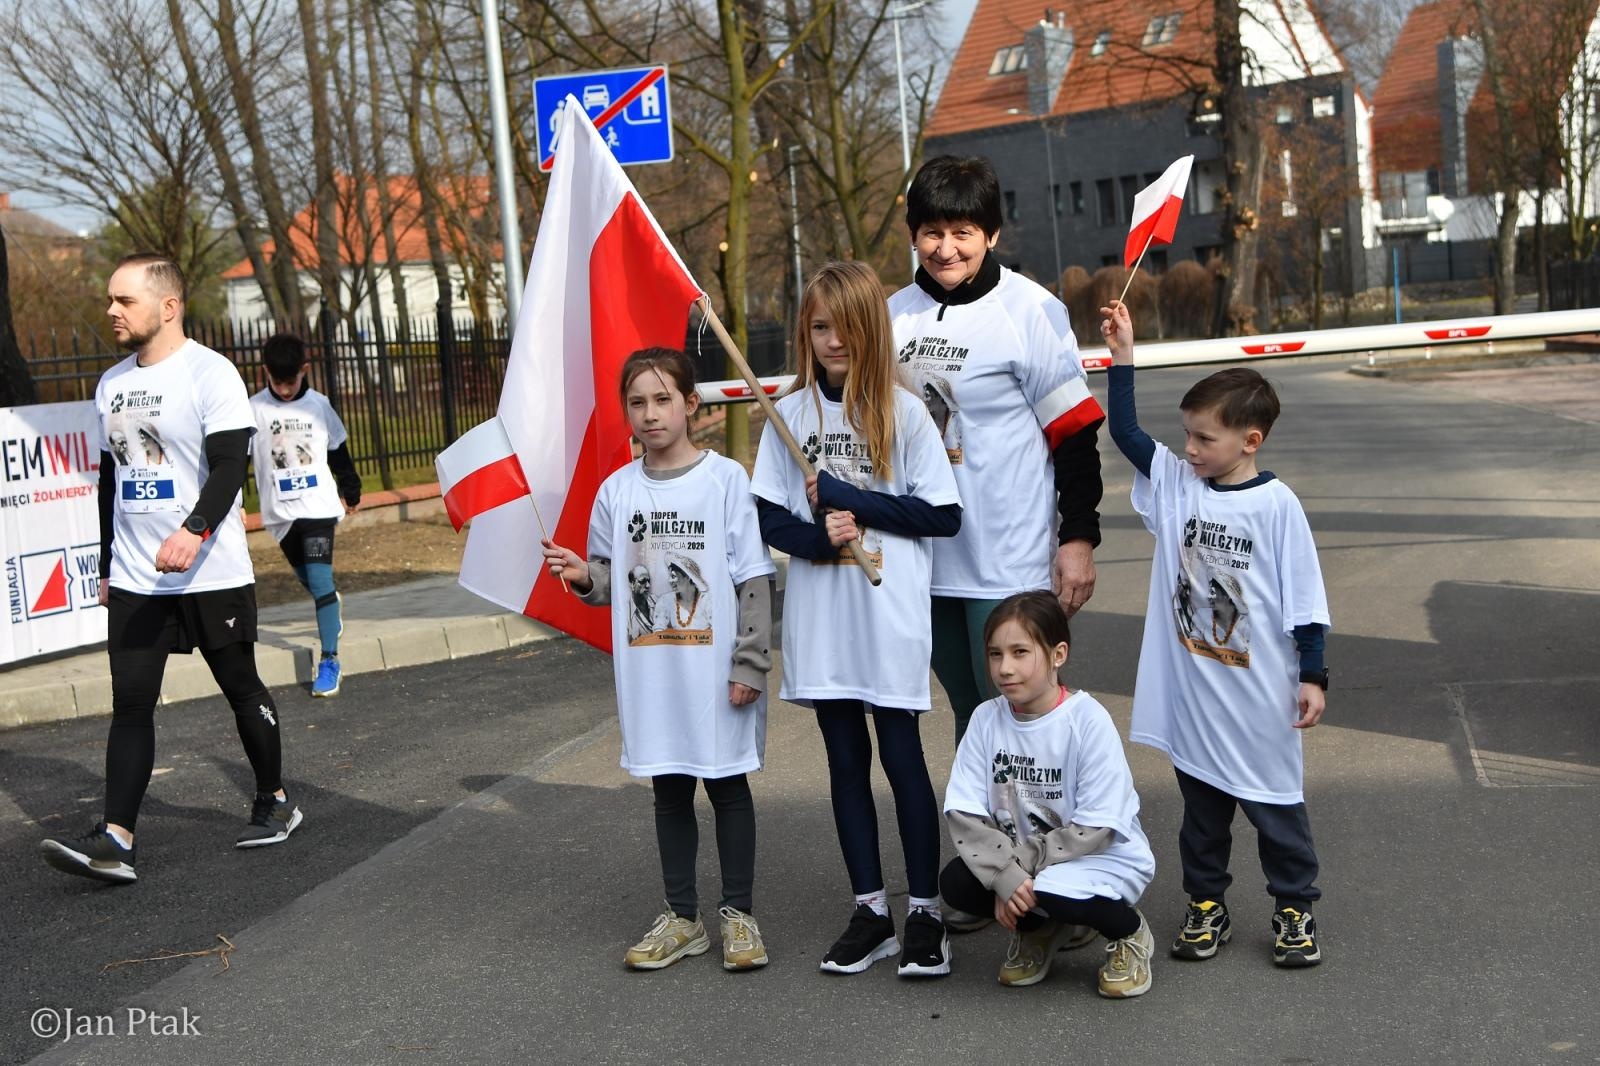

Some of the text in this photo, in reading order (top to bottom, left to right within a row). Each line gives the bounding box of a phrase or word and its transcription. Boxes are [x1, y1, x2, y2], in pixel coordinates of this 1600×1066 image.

[921, 336, 948, 345] TROPEM
[917, 344, 969, 360] WILCZYM
[945, 364, 962, 372] 2026
[127, 395, 162, 408] WILCZYM
[825, 433, 851, 442] TROPEM
[860, 464, 873, 474] 202
[291, 477, 308, 490] 54
[135, 481, 158, 499] 56
[650, 511, 678, 520] TROPEM
[651, 521, 705, 535] WILCZYM
[1200, 520, 1227, 534] TROPEM
[650, 541, 705, 550] XIV EDYCJA 2026
[1199, 530, 1253, 555] WILCZYM
[1231, 559, 1249, 571] 2026
[5, 556, 23, 624] FUNDACJA
[1045, 789, 1063, 800] 2026
